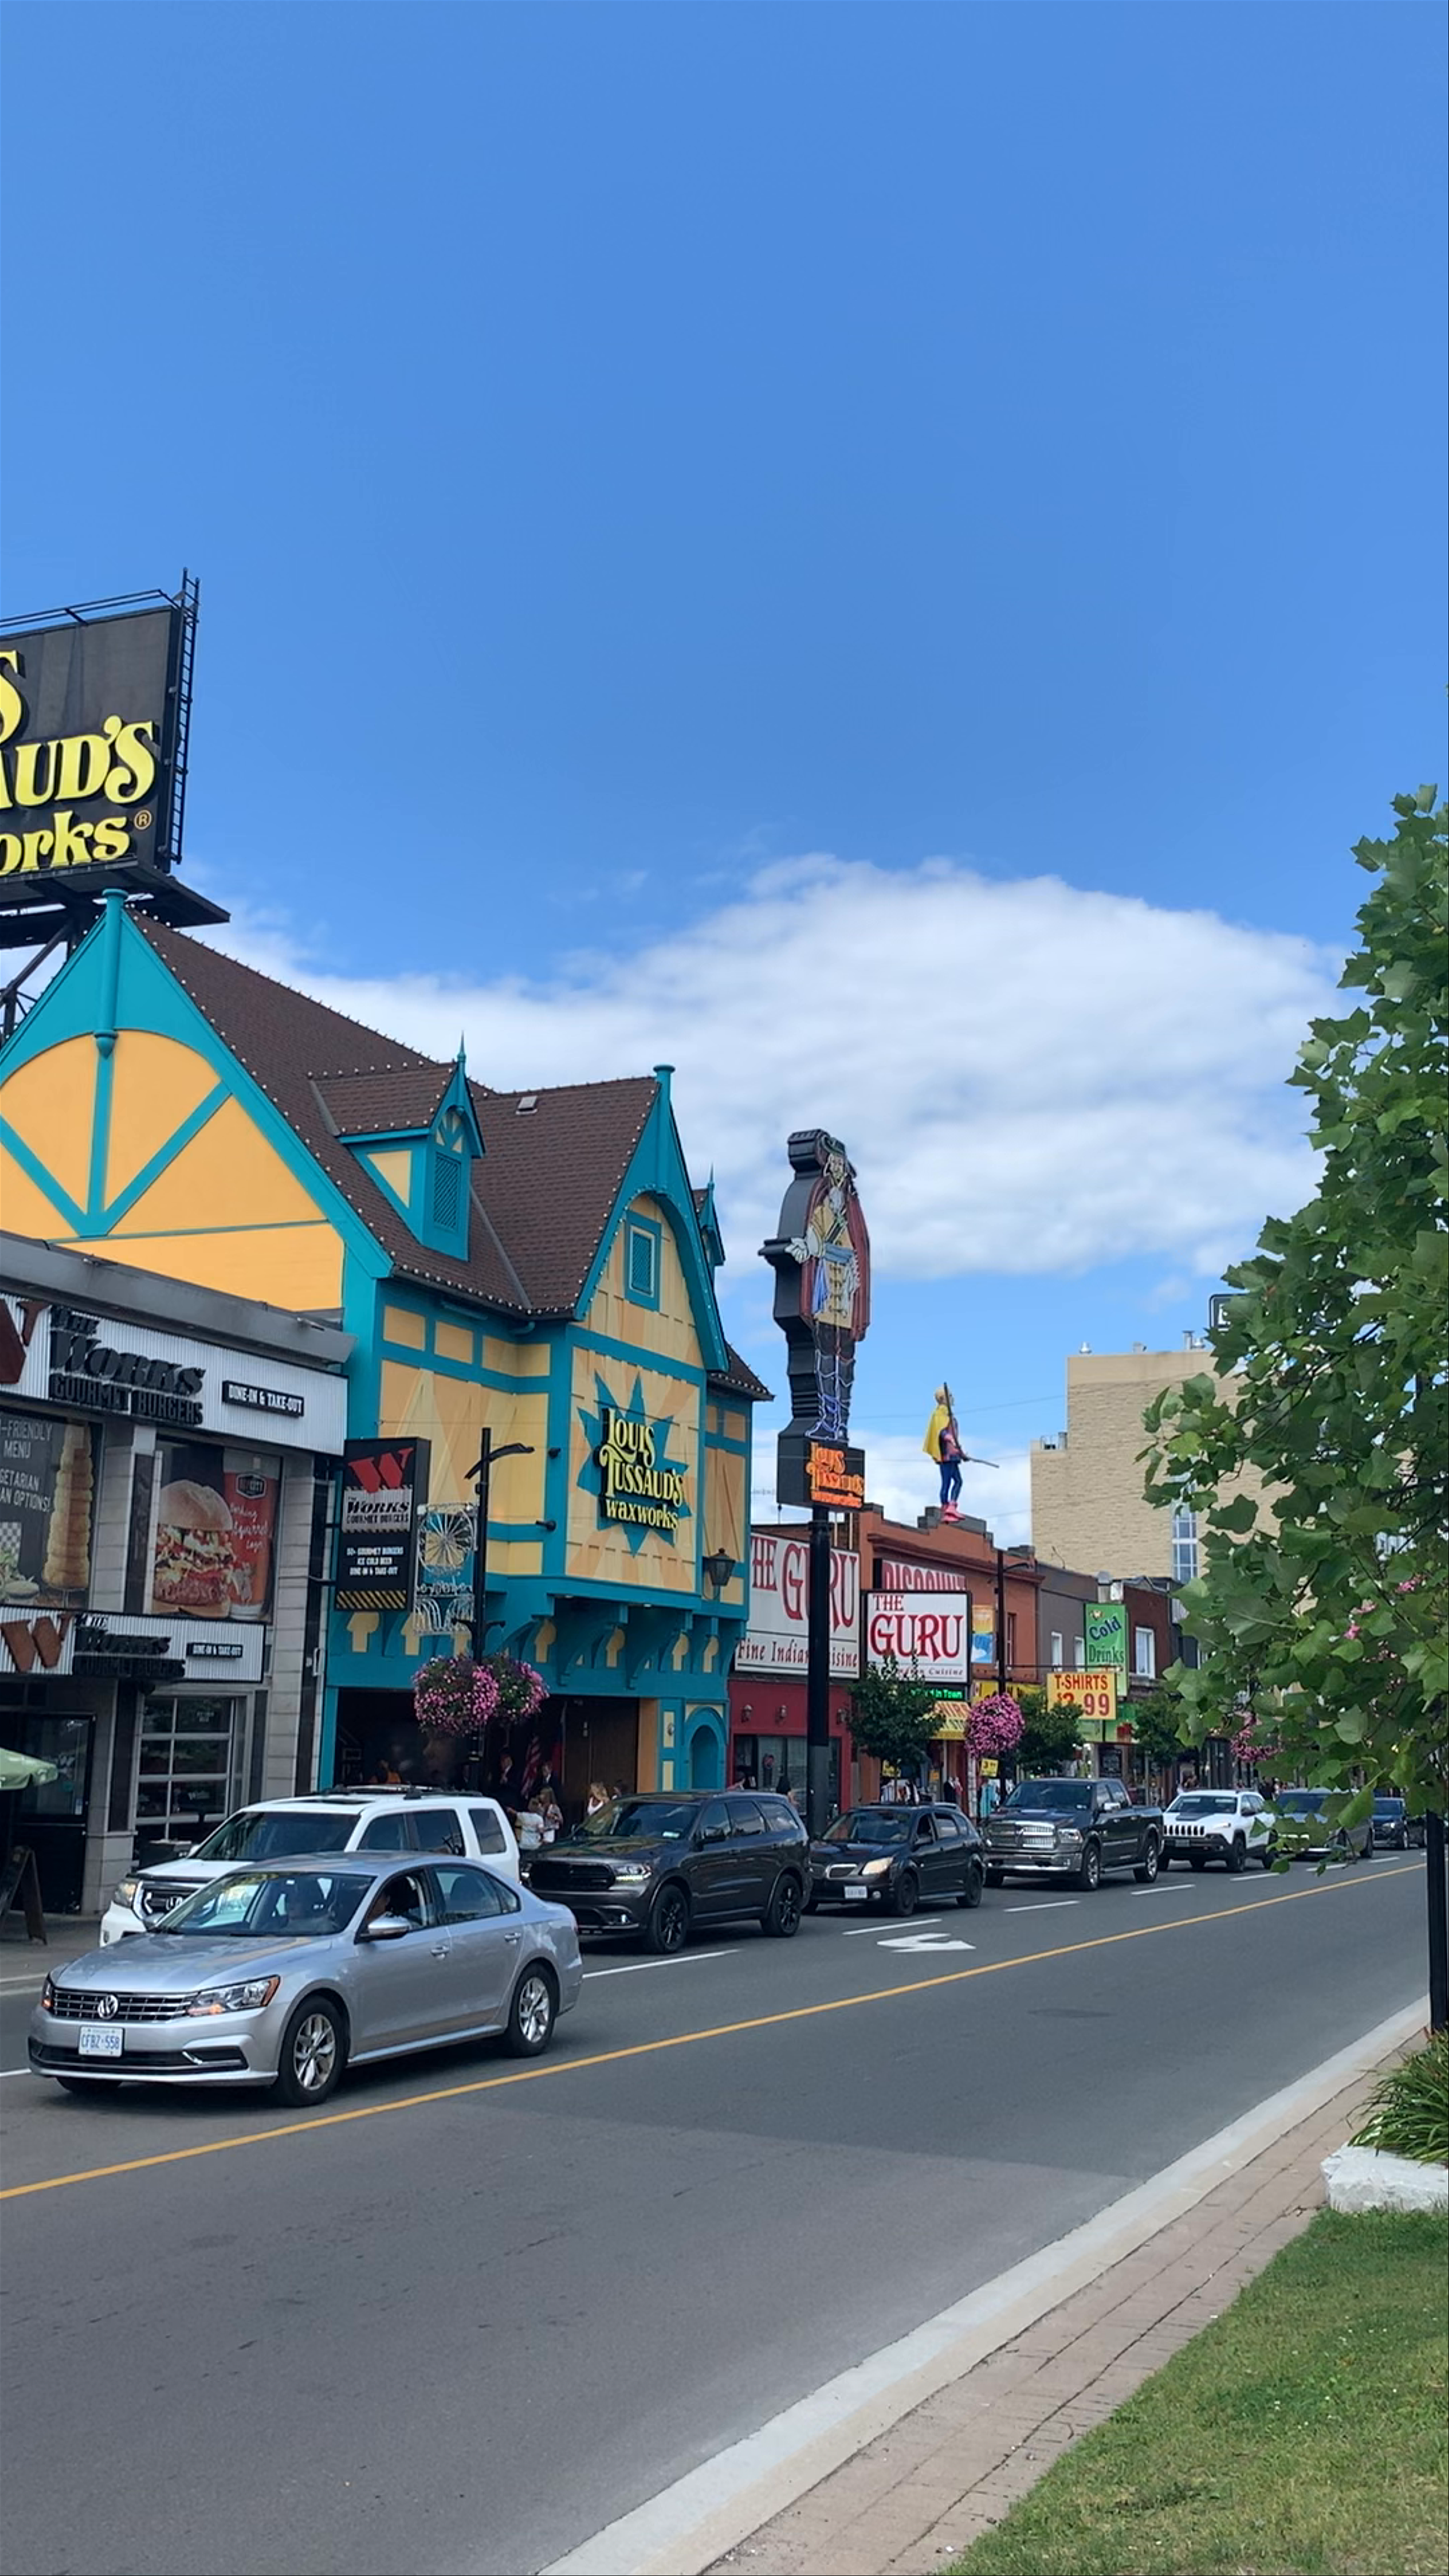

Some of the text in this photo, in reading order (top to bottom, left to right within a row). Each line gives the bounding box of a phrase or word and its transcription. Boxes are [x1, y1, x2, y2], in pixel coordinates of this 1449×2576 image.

[267, 1393, 303, 1413] TAKE-OUT
[3, 1440, 31, 1459] MENU
[607, 1408, 655, 1468] LOUIS
[348, 1447, 414, 1493] W
[599, 1444, 683, 1507] TUSSAUD'S
[14, 1490, 51, 1512] OPTIONS!
[872, 1595, 904, 1612] THE
[870, 1614, 964, 1662] GURU
[1089, 1616, 1122, 1641] Cold
[1, 1612, 74, 1673] W
[1089, 1644, 1124, 1664] Drinks
[1054, 1674, 1109, 1690] T-SHIRTS
